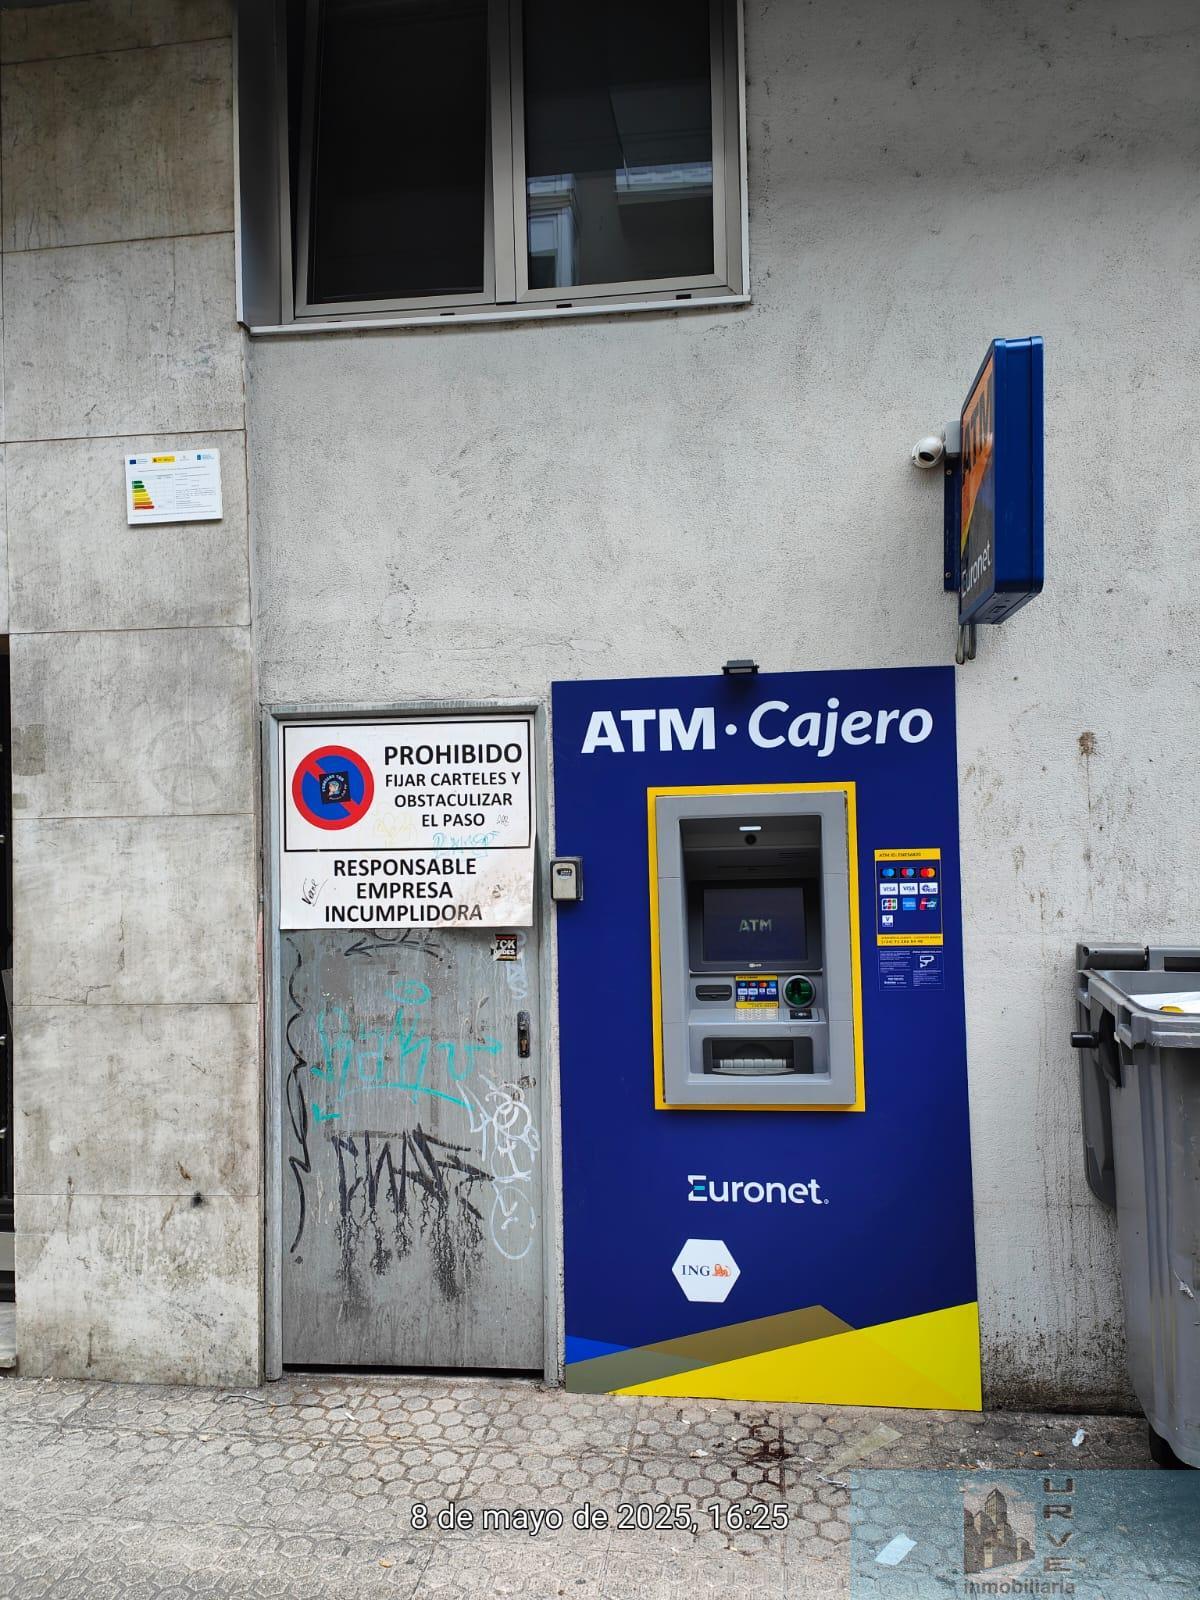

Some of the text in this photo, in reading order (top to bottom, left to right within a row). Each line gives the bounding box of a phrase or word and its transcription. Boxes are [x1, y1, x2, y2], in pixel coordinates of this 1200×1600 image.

[961, 538, 993, 600] Euronet
[580, 697, 933, 758] ATM Cajero
[384, 743, 522, 766] PROHIBIDO
[385, 771, 521, 788] FIJAR CARTELES Y
[394, 792, 513, 808] OBSTACULIZAR
[422, 814, 438, 828] EL
[443, 813, 485, 828] PASO
[334, 858, 477, 877] RESPONSABLE
[356, 881, 453, 900] EMPRESA
[325, 904, 483, 923] INCUMPLIDORA
[739, 919, 773, 933] ATM
[681, 1264, 711, 1278] ING
